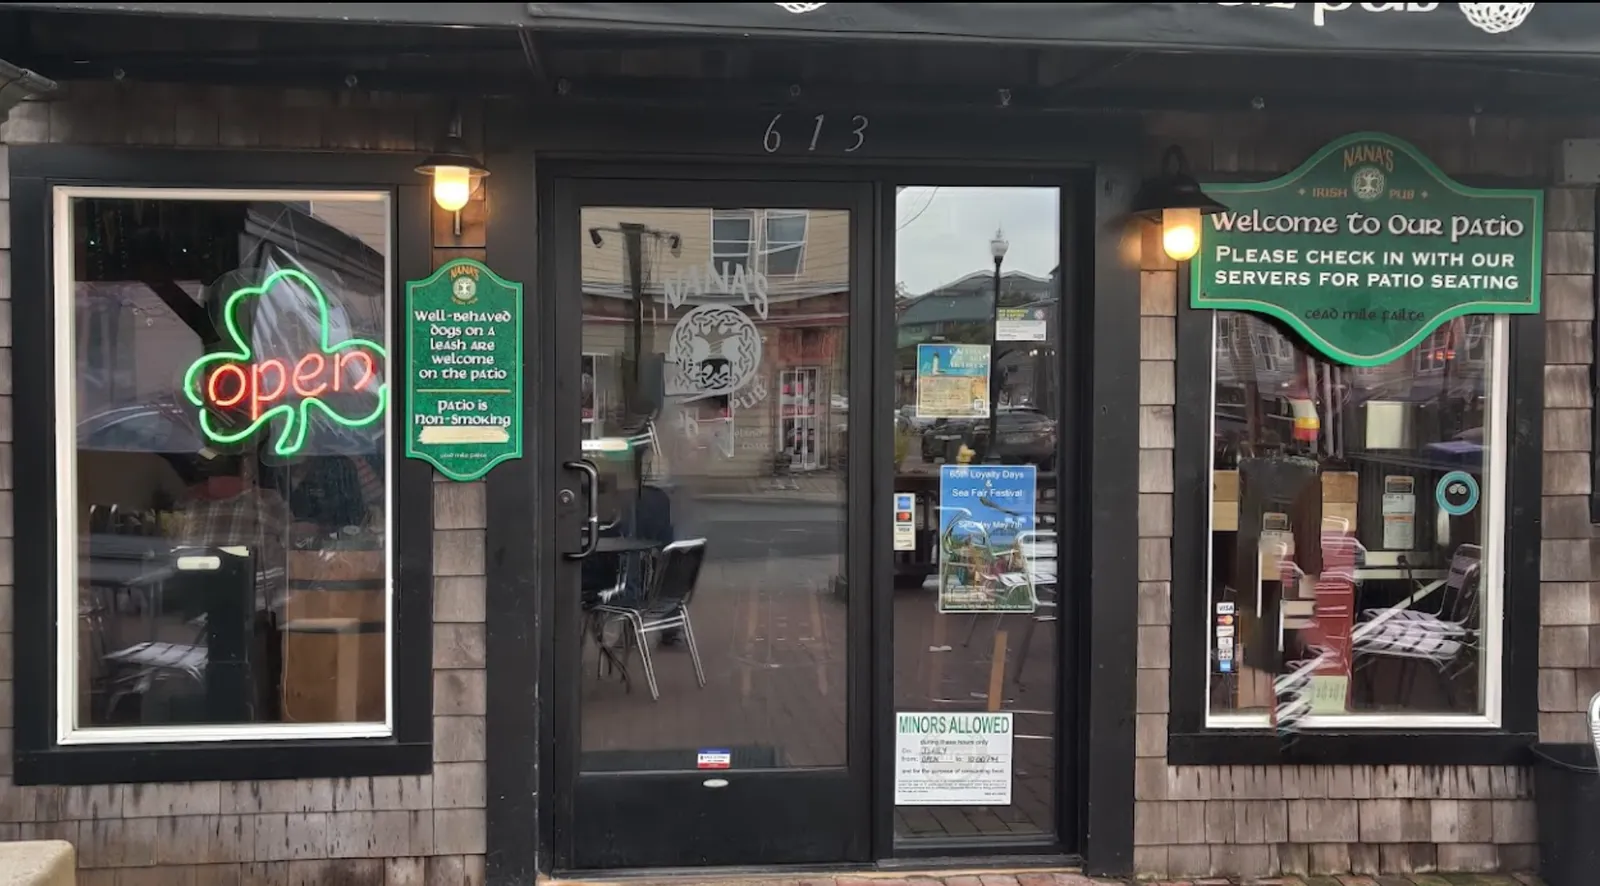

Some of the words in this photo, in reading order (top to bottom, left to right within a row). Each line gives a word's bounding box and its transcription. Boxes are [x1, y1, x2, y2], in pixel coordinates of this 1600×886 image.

[1343, 144, 1394, 172] NANA'S
[1312, 187, 1348, 198] IRISH
[1389, 188, 1416, 200] PUB
[1210, 209, 1338, 233] Welcome
[1215, 245, 1299, 263] PLEASE
[1306, 250, 1375, 265] CHECK
[1383, 252, 1404, 265] IN
[1412, 252, 1464, 266] WITH
[1471, 253, 1515, 267] OUR
[1215, 270, 1311, 285] SERVERS
[1319, 272, 1359, 286] FOR
[1367, 273, 1424, 288] PATIO
[1431, 275, 1519, 290] SEATING
[664, 261, 768, 321] NANA'S
[430, 324, 461, 338] dogs
[465, 326, 484, 336] on
[430, 338, 466, 350] leash
[431, 352, 494, 364] welcome
[419, 369, 438, 379] on
[442, 368, 467, 379] the
[470, 368, 507, 381] patio
[208, 351, 372, 421] open
[477, 399, 488, 411] is
[970, 470, 1001, 479] Loyalty
[1002, 470, 1024, 479] Days
[952, 489, 969, 497] Sea
[971, 489, 987, 497] Fair
[990, 489, 1023, 497] Festival
[899, 716, 946, 734] MINORS
[949, 716, 1010, 734] ALLOWED
